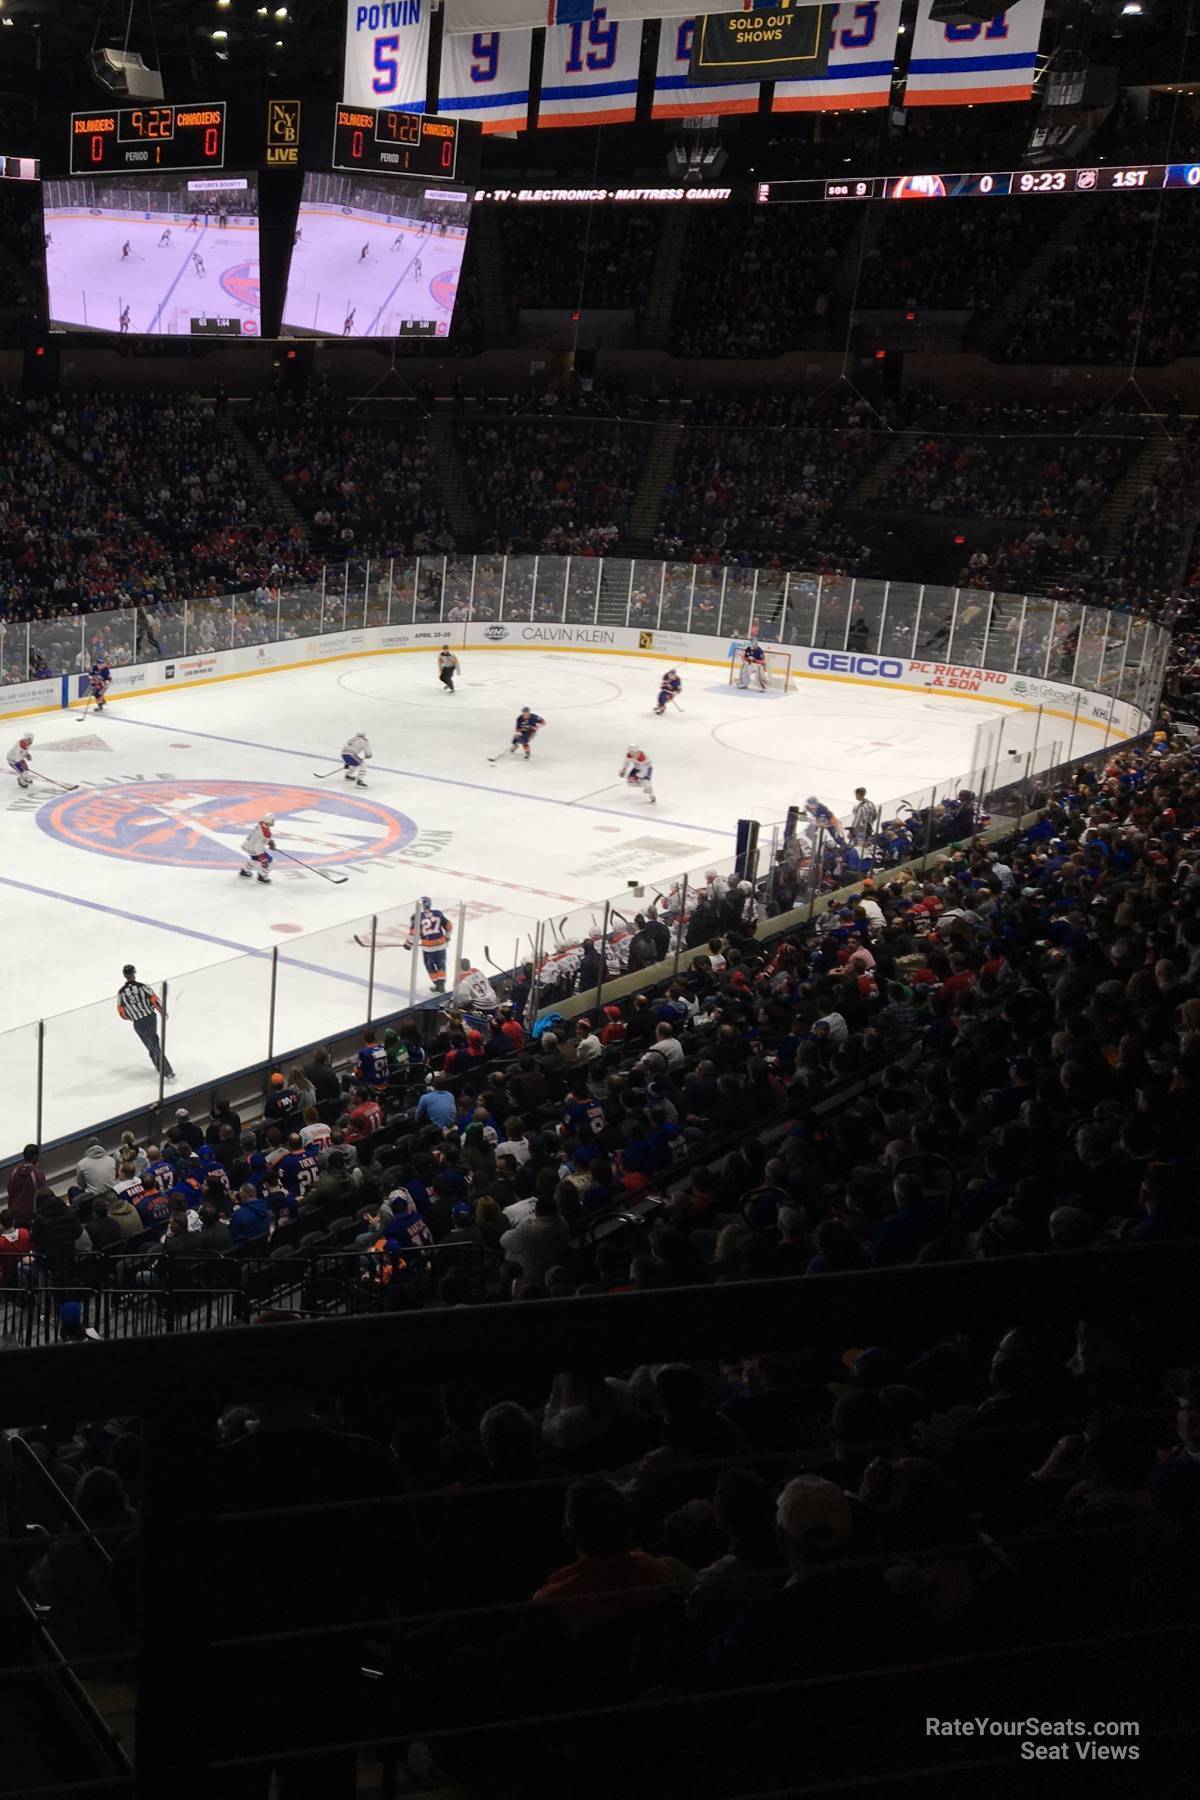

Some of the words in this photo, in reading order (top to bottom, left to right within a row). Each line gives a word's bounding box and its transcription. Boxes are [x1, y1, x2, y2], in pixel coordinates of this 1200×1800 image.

[356, 0, 420, 32] POTVIN
[729, 16, 765, 31] SOLD
[767, 13, 794, 29] OUT
[829, 0, 877, 49] 3
[565, 8, 619, 73] 19
[736, 29, 783, 43] SHOWS
[372, 34, 399, 95] 5
[470, 31, 500, 83] 9
[74, 117, 115, 133] ISLANDERS
[177, 111, 221, 127] CANADIENS
[338, 112, 374, 129] ISLANDERS
[422, 123, 455, 137] CANADIENS
[91, 135, 103, 161] 0
[125, 151, 148, 162] PERIOD
[155, 146, 161, 164] 1
[205, 128, 218, 156] 0
[266, 148, 298, 162] LIVE
[352, 131, 364, 158] 0
[380, 152, 399, 163] PERIOD
[404, 151, 409, 168] 1
[442, 141, 452, 167] 0
[828, 186, 848, 195] SOG
[856, 183, 867, 195] 9
[979, 176, 993, 192] 0
[1020, 173, 1066, 191] 9:23
[1112, 171, 1148, 187] 1ST
[494, 190, 511, 201] TV
[518, 190, 607, 201] ELECTRONICS
[614, 189, 684, 200] MATTRESS
[686, 188, 731, 199] GIANT!
[522, 626, 573, 641] CALVIN
[576, 630, 615, 643] KLEIN
[808, 651, 903, 679] GEICO
[908, 661, 932, 674] PC
[934, 665, 1008, 685] RICHARD
[933, 676, 944, 687] &
[946, 678, 981, 692] SON
[421, 917, 441, 935] 27
[155, 1171, 174, 1192] 17
